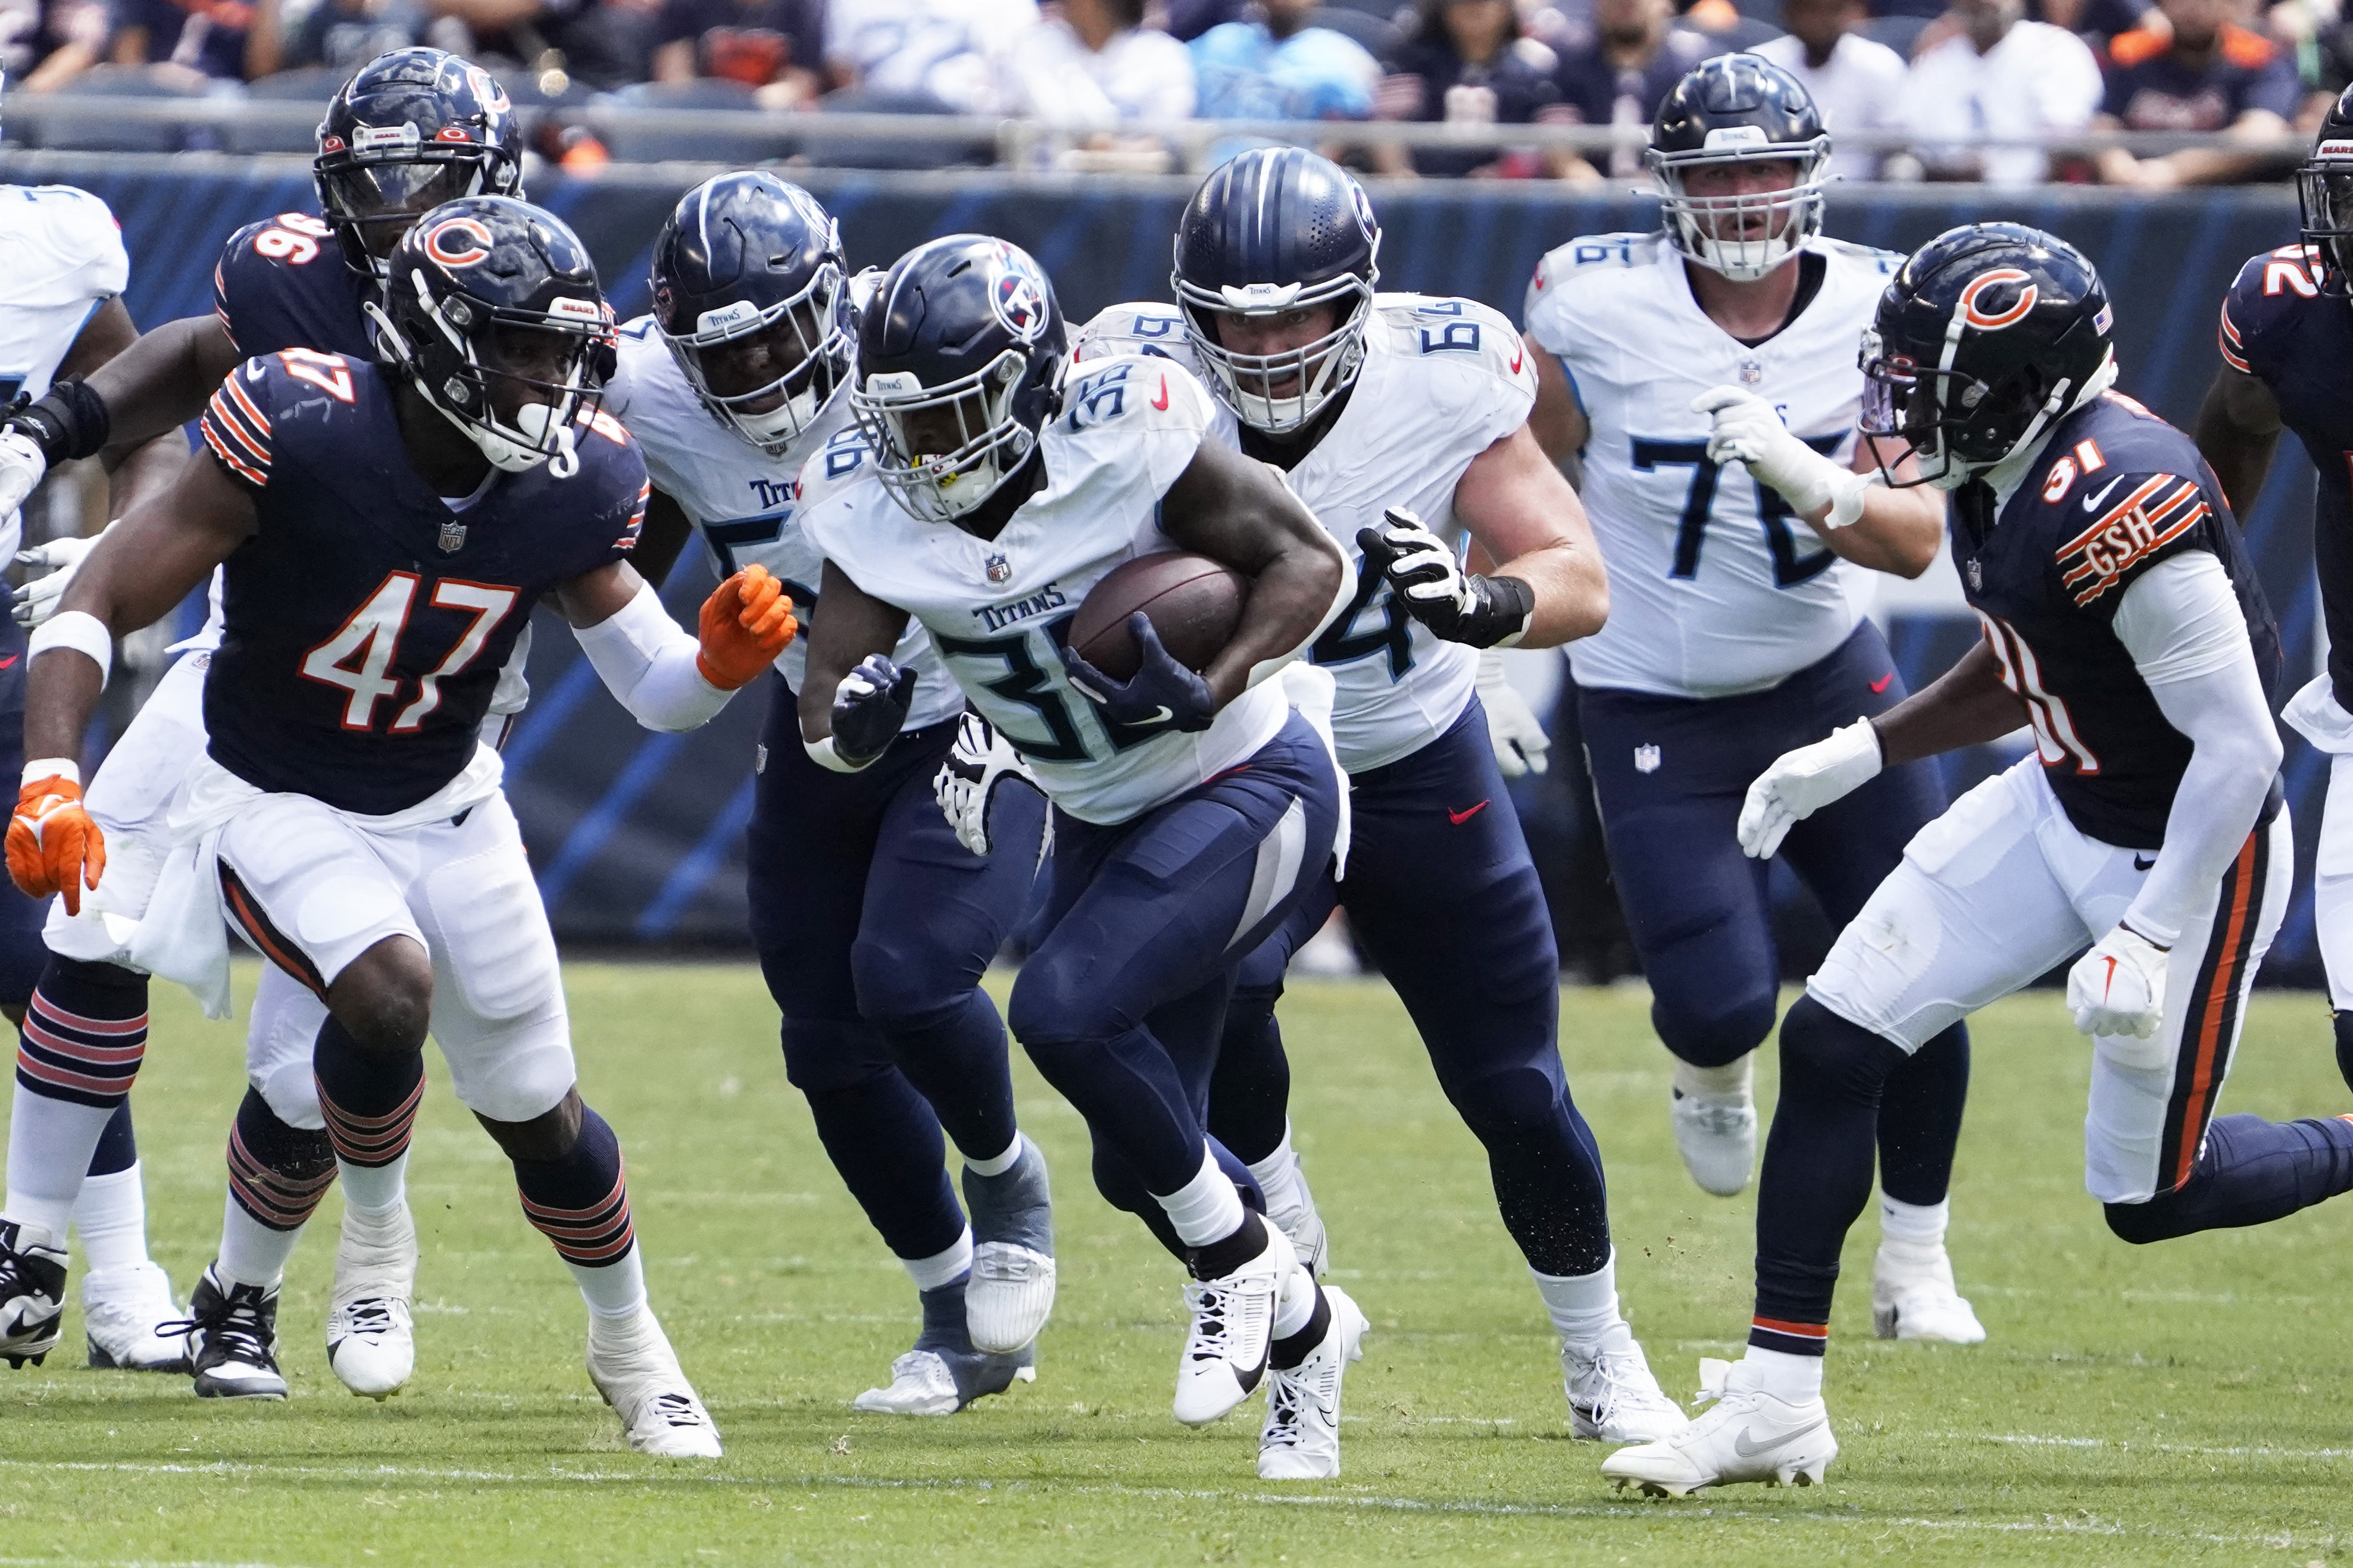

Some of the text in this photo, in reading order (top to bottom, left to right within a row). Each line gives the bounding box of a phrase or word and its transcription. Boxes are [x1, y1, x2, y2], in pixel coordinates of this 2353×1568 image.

[424, 217, 493, 269] C
[561, 303, 594, 315] BEARS
[1248, 286, 1271, 295] TITANS
[1958, 268, 2039, 330] C
[708, 308, 741, 327] TITANS
[1416, 301, 1482, 356] 64
[277, 347, 357, 403] 47
[874, 378, 903, 391] TITANS
[748, 478, 799, 510] TIT
[2042, 438, 2106, 504] 31
[2084, 504, 2157, 578] GSH
[971, 581, 1067, 633] TITANS
[1307, 550, 1417, 685] 4
[297, 569, 522, 734] 47
